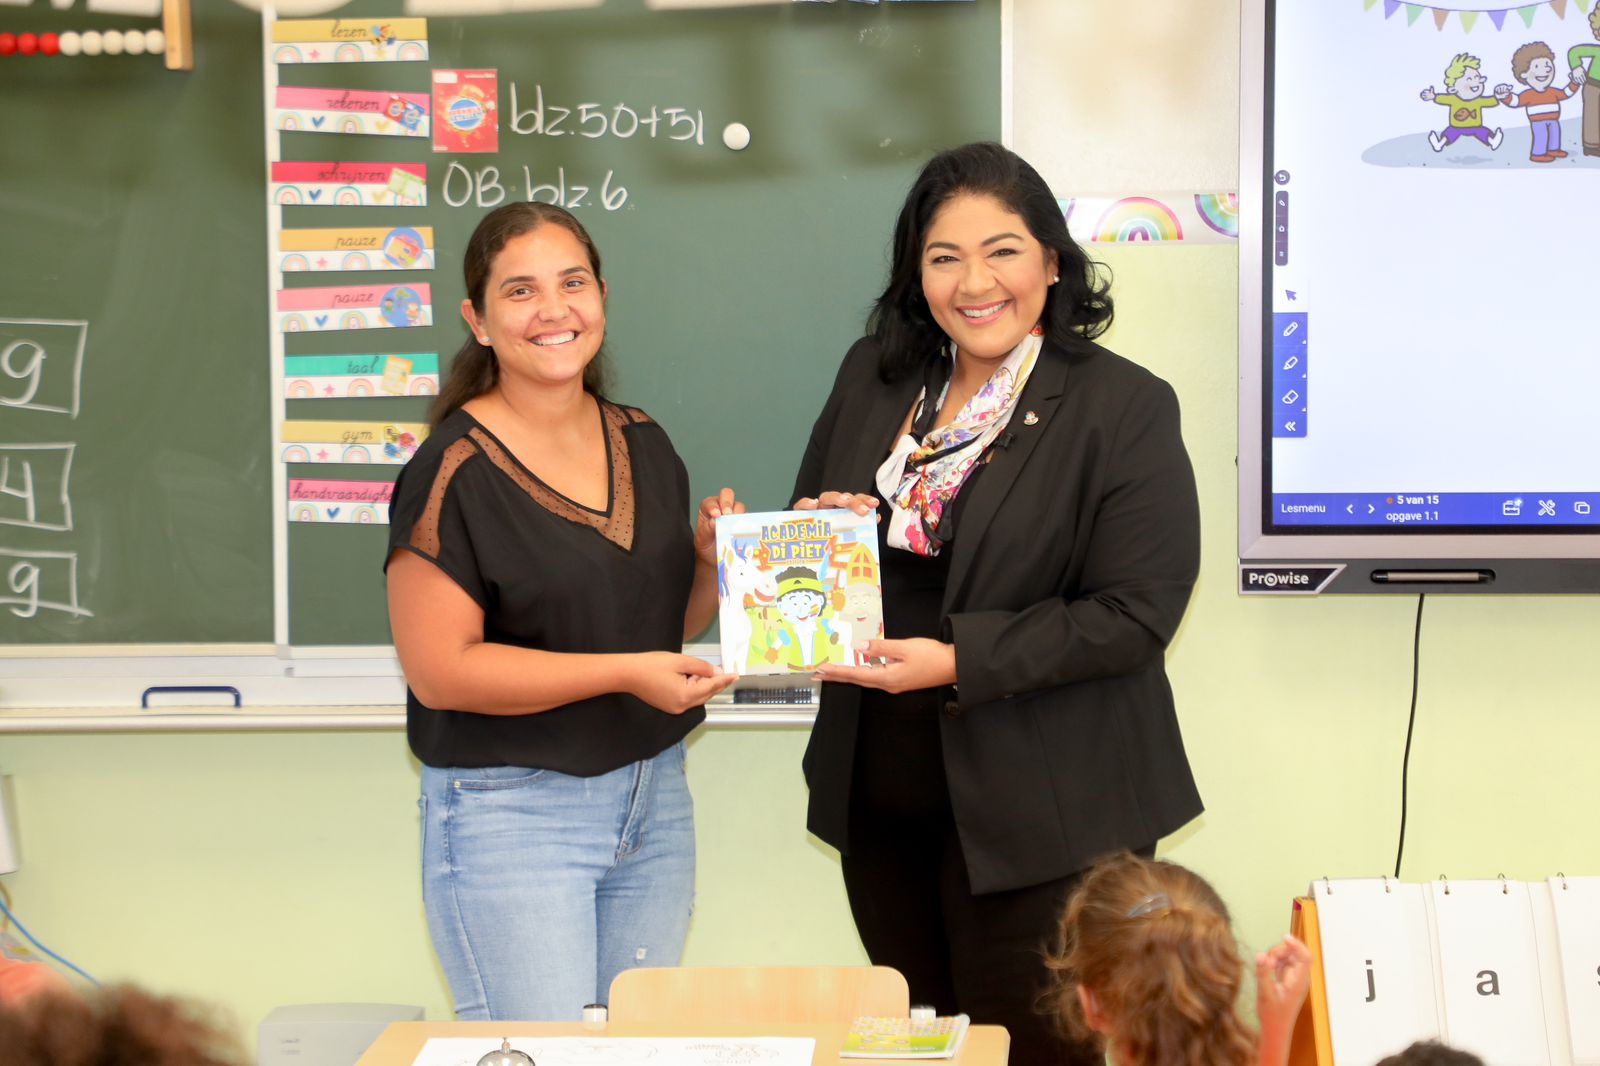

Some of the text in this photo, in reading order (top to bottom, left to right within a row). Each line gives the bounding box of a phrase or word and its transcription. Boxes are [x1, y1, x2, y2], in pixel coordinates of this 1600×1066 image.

[330, 19, 368, 39] lezen
[443, 161, 506, 208] OB
[601, 169, 628, 211] 6
[335, 236, 377, 249] pauze
[331, 292, 374, 308] pauze
[346, 355, 380, 374] taal
[341, 430, 374, 448] gym
[1397, 495, 1440, 505] 5 van 15
[1281, 503, 1326, 514] Lesmenu
[1386, 511, 1439, 523] opgave 1.1
[1248, 572, 1310, 587] Prowise
[1365, 960, 1501, 1003] j a
